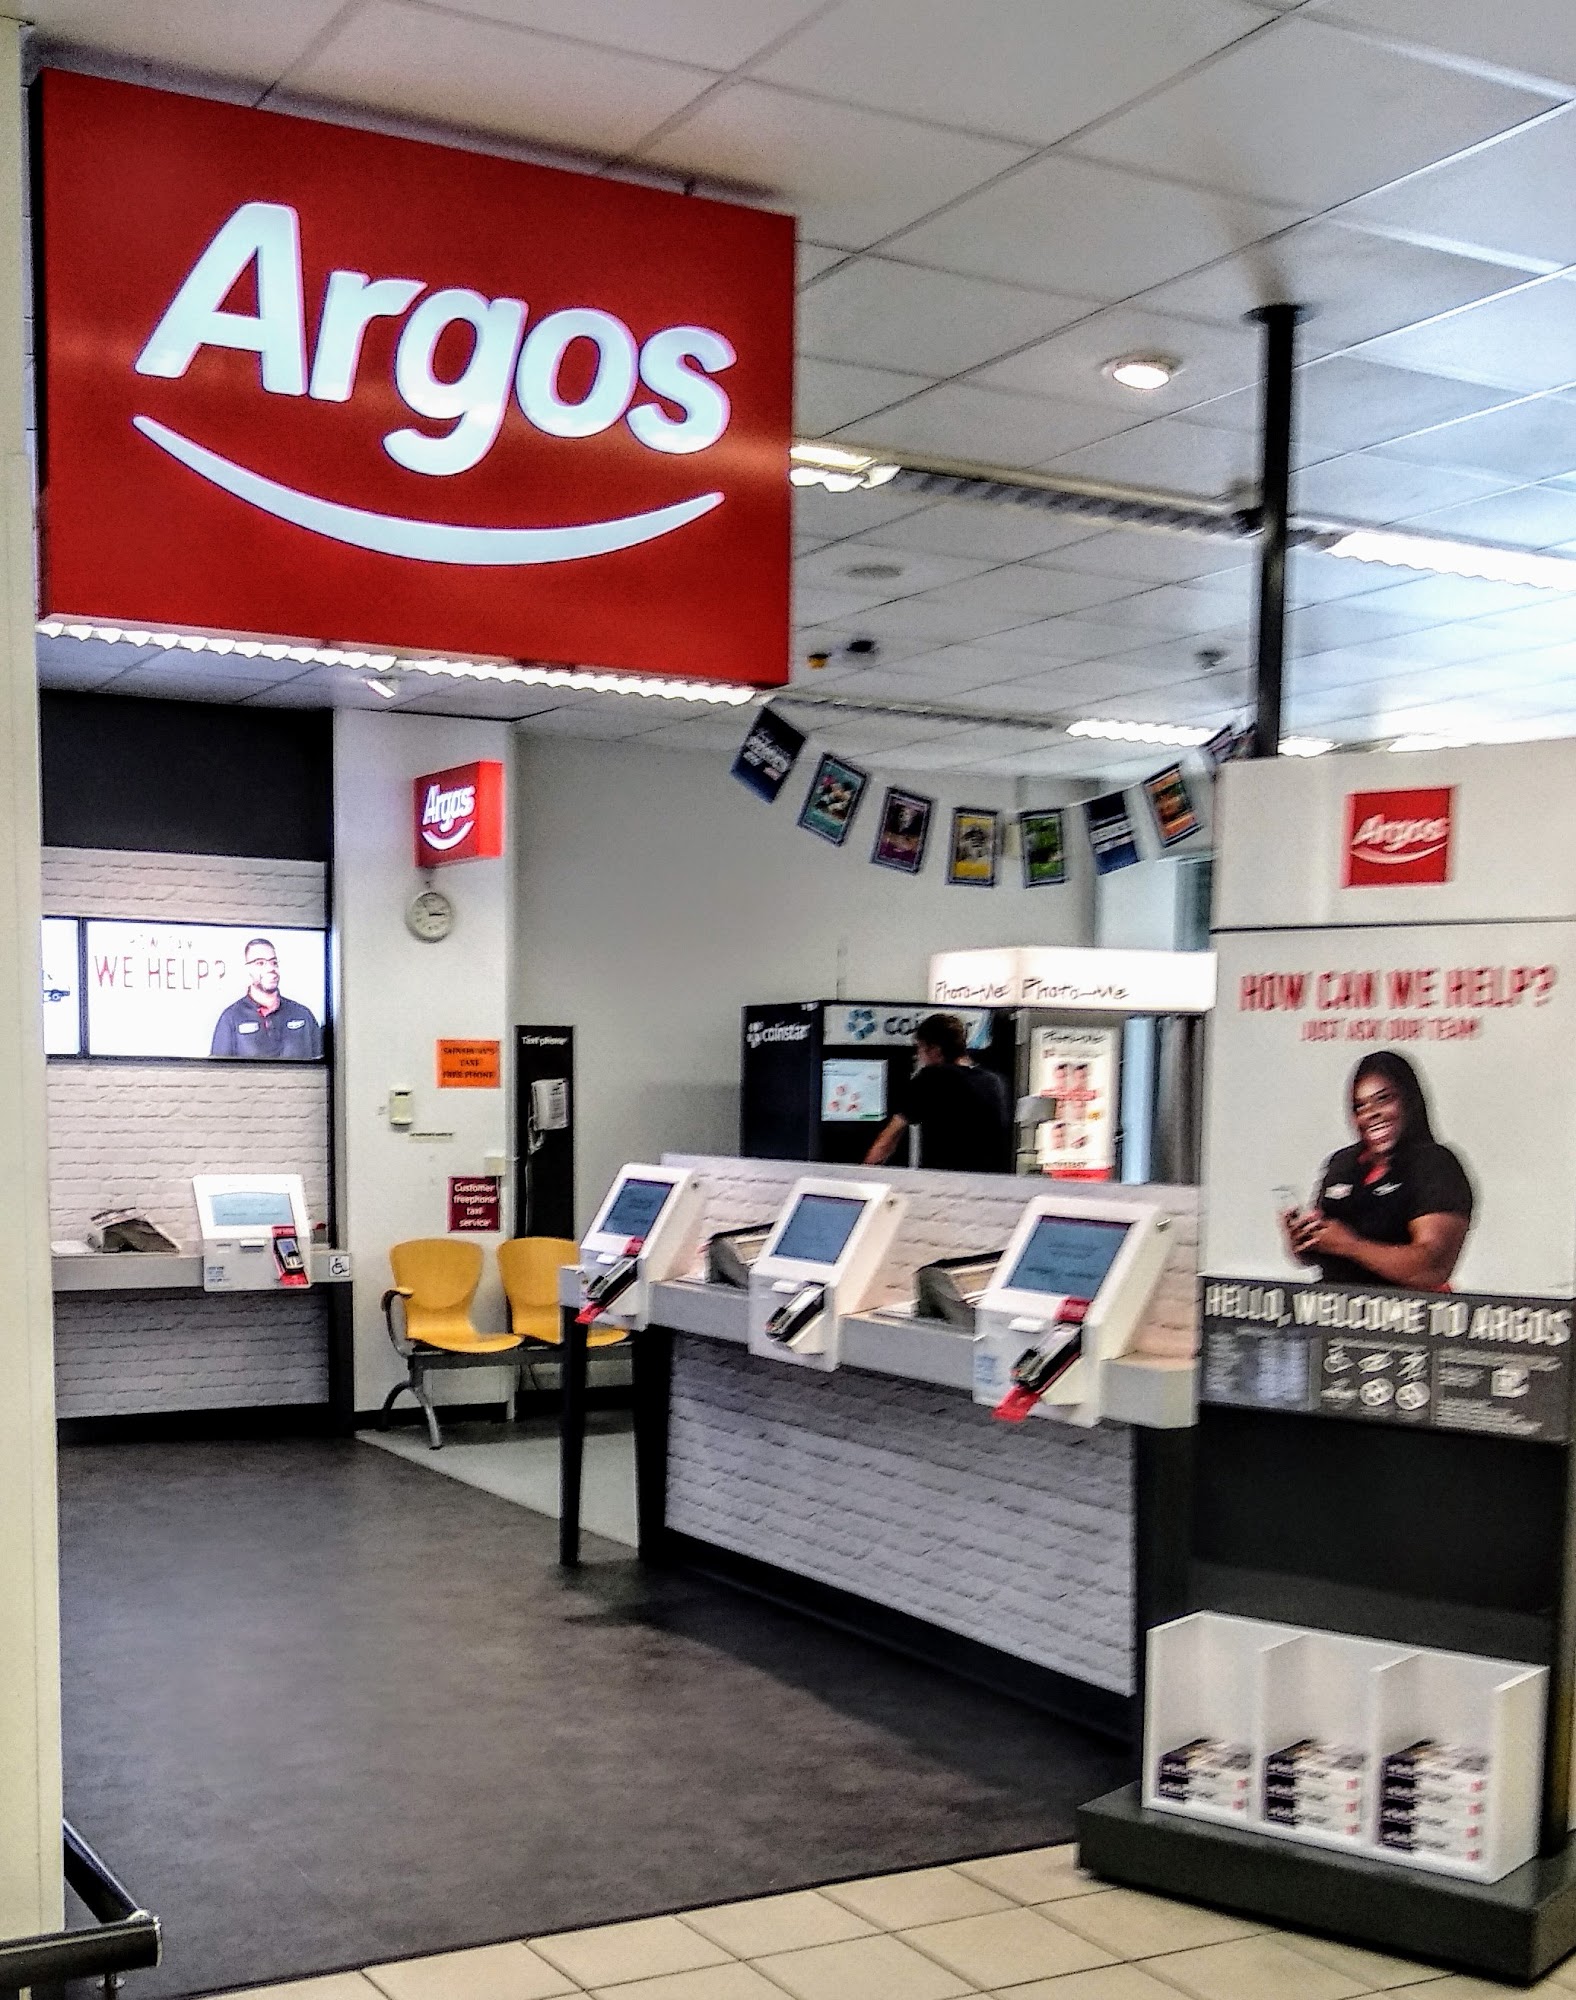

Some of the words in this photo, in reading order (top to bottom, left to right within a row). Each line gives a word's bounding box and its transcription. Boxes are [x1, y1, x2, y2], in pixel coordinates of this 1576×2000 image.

[134, 202, 738, 476] Argos
[422, 784, 476, 832] Argos
[1351, 813, 1450, 852] Argos
[94, 956, 134, 988] WE
[147, 957, 226, 990] HELP?
[1239, 971, 1309, 1011] HOW
[1316, 970, 1378, 1010] CAN
[1386, 968, 1436, 1008] WE
[1445, 963, 1558, 1009] HELP?
[762, 1021, 812, 1042] coinstar
[453, 1194, 497, 1206] freephone
[454, 1183, 496, 1193] Customer
[459, 1218, 492, 1228] service
[466, 1206, 484, 1216] taxi
[1204, 1283, 1293, 1328] HELLO,
[1293, 1289, 1428, 1335] WELCOME
[1429, 1301, 1469, 1338] TO
[1468, 1303, 1574, 1347] ARGOS
